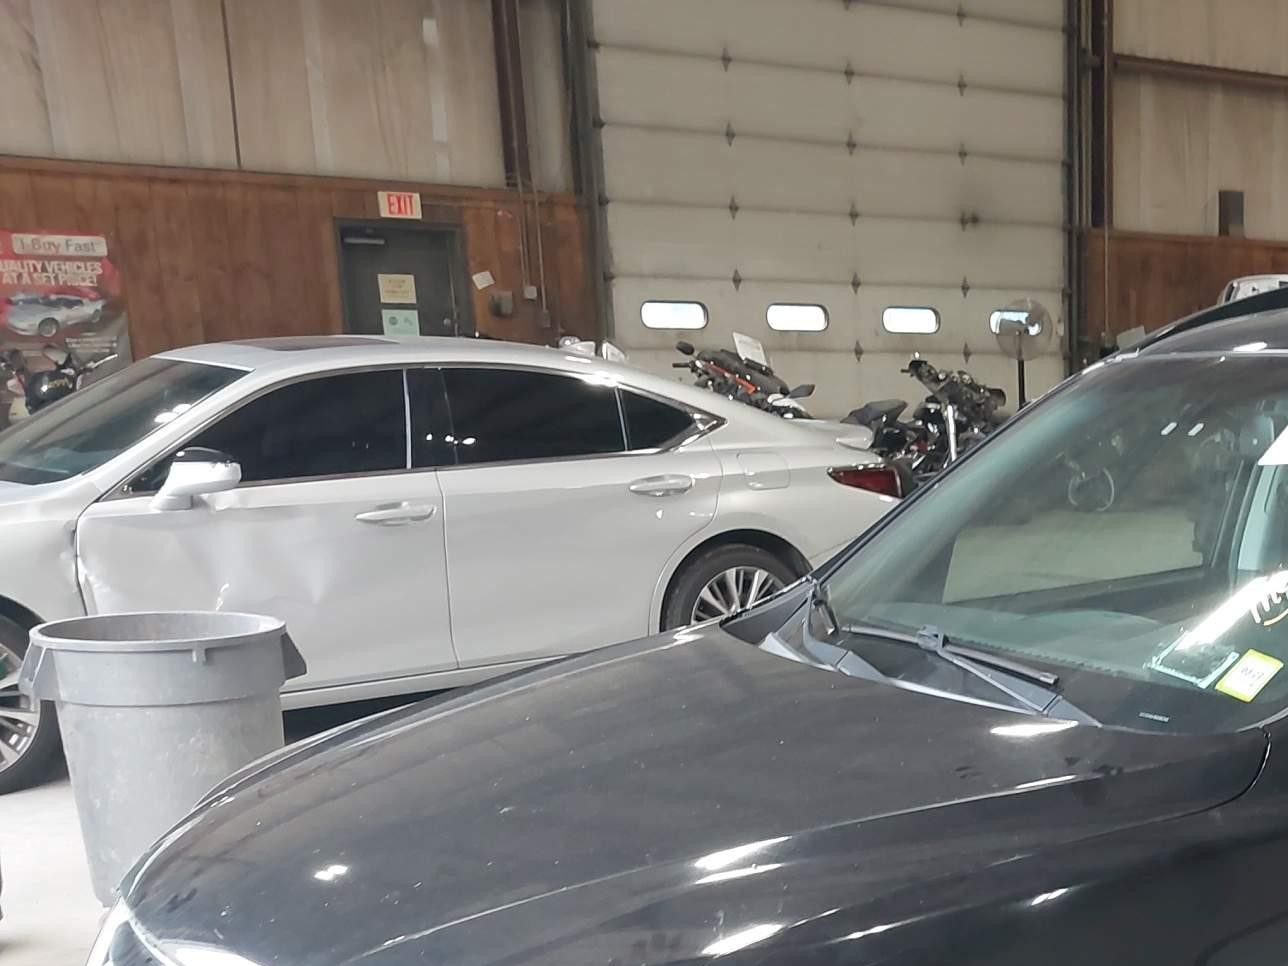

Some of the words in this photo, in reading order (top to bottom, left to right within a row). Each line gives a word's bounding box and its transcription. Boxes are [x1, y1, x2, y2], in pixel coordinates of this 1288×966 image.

[387, 193, 414, 216] EXIT
[65, 239, 96, 253] Fast
[44, 261, 103, 275] VEHICLES
